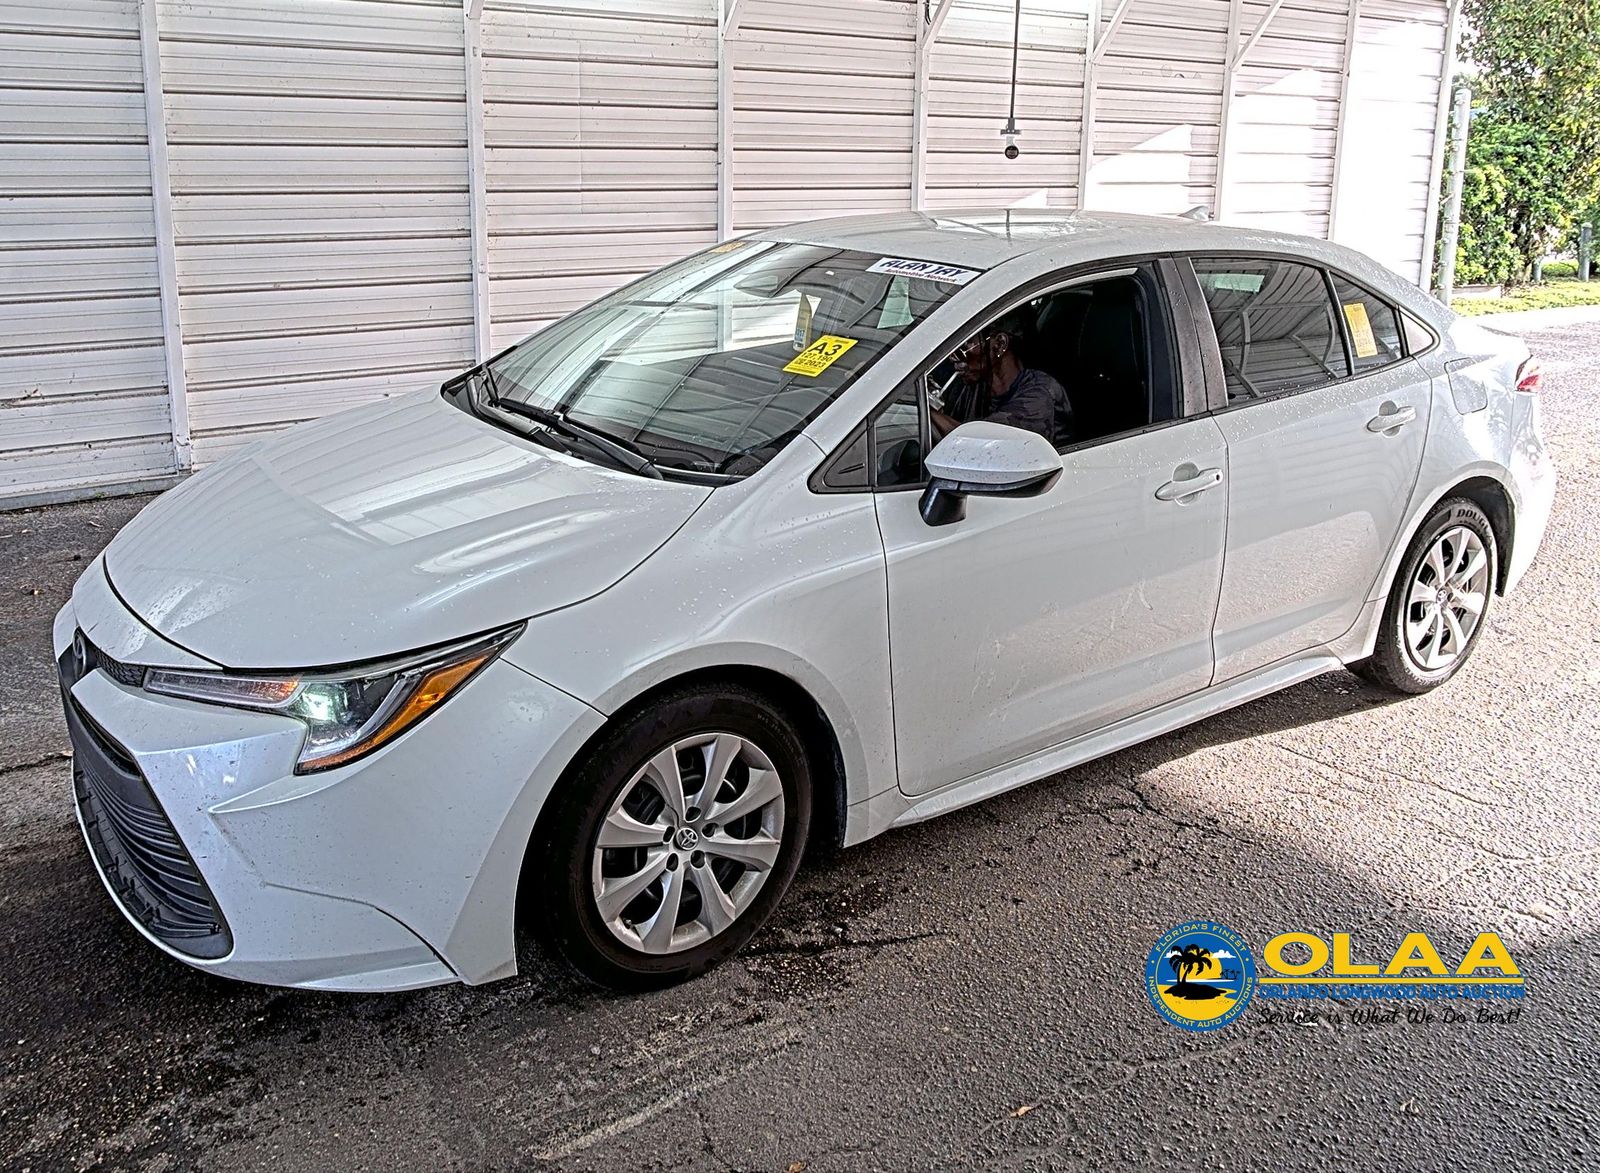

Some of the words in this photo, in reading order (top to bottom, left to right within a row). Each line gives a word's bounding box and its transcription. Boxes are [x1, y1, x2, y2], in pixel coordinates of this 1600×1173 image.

[880, 260, 932, 271] ALAN
[925, 266, 969, 277] JAY
[807, 341, 843, 356] A3
